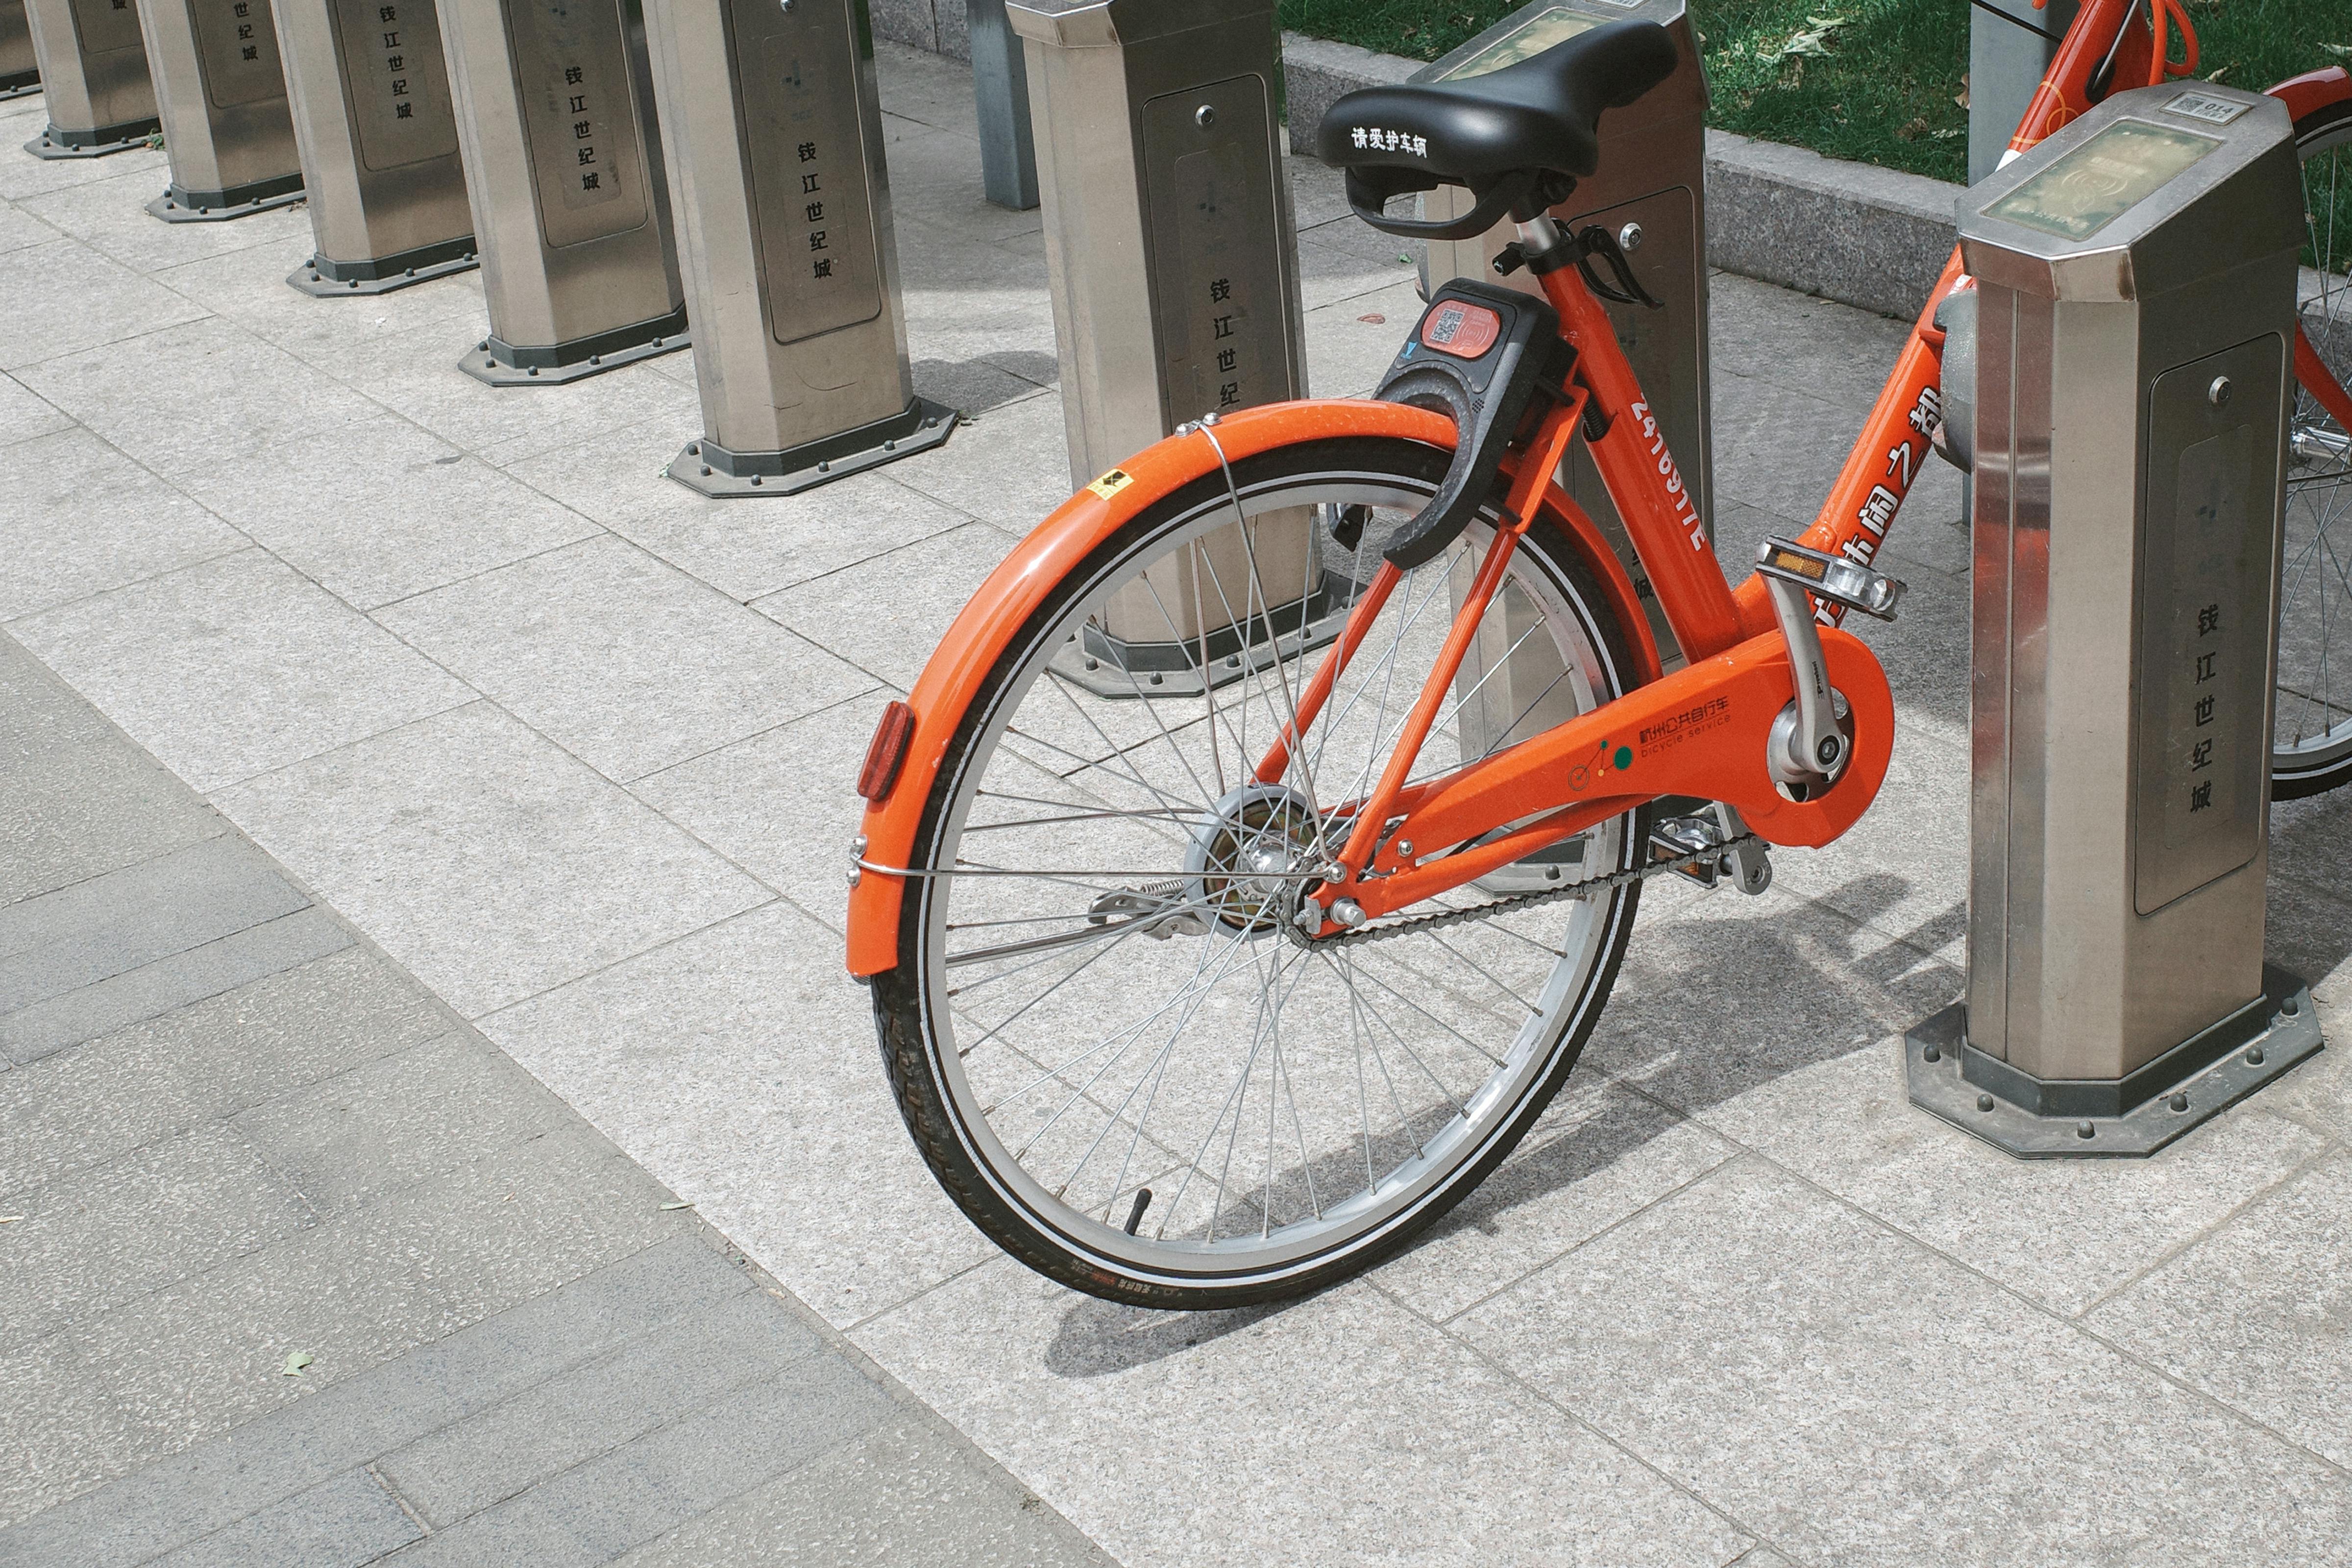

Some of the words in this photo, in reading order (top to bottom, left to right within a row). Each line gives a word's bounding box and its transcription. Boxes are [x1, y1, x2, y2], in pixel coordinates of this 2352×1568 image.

[234, 2, 258, 61] 世纪城
[380, 6, 413, 119] 钱江世纪城
[565, 66, 600, 191] 钱江世纪城
[1351, 127, 1427, 158] 请爱护车辆
[2205, 103, 2233, 114] 014
[798, 142, 833, 279] 钱江世纪城
[1642, 735, 1683, 758] bicycle
[1689, 714, 1730, 737] service
[2190, 603, 2219, 812] 钱江世纪城
